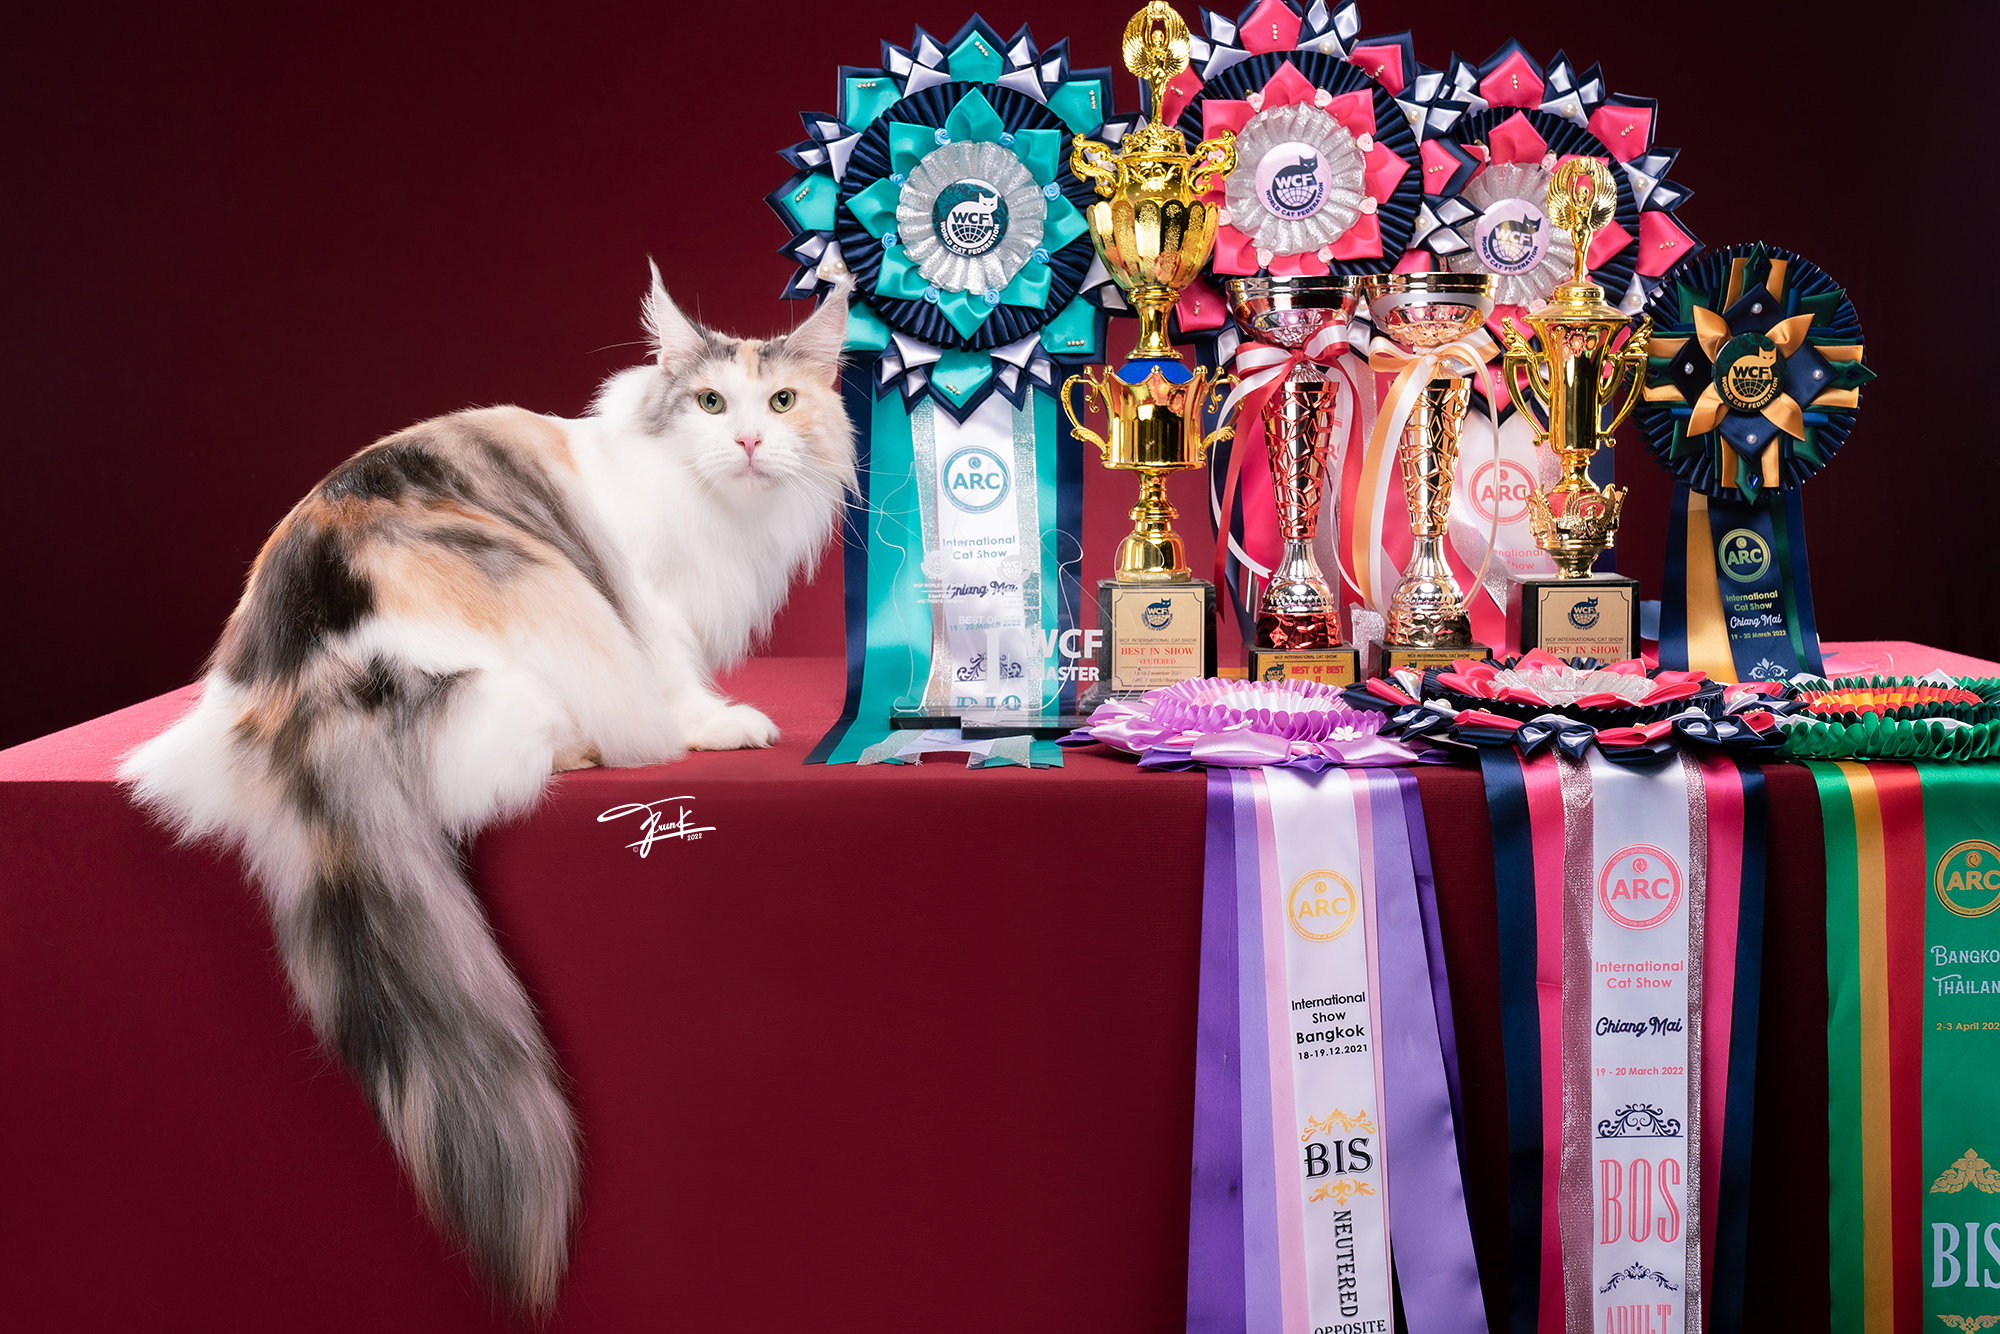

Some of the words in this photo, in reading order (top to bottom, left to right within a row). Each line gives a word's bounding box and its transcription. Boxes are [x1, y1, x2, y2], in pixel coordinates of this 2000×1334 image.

[1274, 173, 1312, 190] WCF
[1266, 189, 1280, 211] WORLD
[1298, 182, 1324, 216] FEDERATION
[952, 212, 989, 224] WCF
[940, 222, 952, 246] WORLD
[952, 244, 966, 254] CAT
[968, 224, 1000, 254] FEDERATION
[1495, 227, 1531, 244] WCF
[1482, 236, 1490, 259] WORLD
[1490, 260, 1503, 269] CAT
[1504, 246, 1538, 271] FEDERATION
[1733, 366, 1769, 378] WCF
[1722, 376, 1733, 400] WORLD
[1733, 399, 1746, 408] CAT
[1748, 377, 1778, 408] FEDERATION
[952, 472, 1000, 490] ARC
[1482, 485, 1526, 502] ARC
[942, 534, 1015, 547] International
[953, 550, 973, 560] Cat
[977, 550, 1007, 559] Show
[1728, 548, 1762, 565] ARC
[1726, 590, 1778, 602] International
[1750, 602, 1772, 610] Show
[1730, 616, 1760, 628] Chiang
[1760, 614, 1782, 626] Mai
[1024, 629, 1103, 658] WCF
[1547, 646, 1571, 654] BEST
[1576, 646, 1586, 654] IN
[1590, 646, 1620, 654] SHOW
[1291, 666, 1309, 674] BEST
[1313, 666, 1323, 674] OF
[1326, 666, 1344, 674] BEST
[1612, 878, 1670, 900] ARC
[1946, 870, 2000, 891] ARC
[1298, 897, 1347, 919] ARC
[1595, 960, 1684, 973] International
[1607, 978, 1631, 988] Cat
[1636, 977, 1672, 988] Show
[1292, 991, 1366, 1011] International
[1312, 1011, 1346, 1024] Show
[1296, 1025, 1365, 1045] Bangkok
[1596, 1017, 1647, 1037] Chiang
[1649, 1016, 1682, 1036] Mai
[1956, 1022, 1978, 1031] April
[1982, 1022, 2000, 1030] 202
[1298, 1044, 1368, 1060] 18-19.12.2021
[1596, 1068, 1606, 1076] 19
[1616, 1068, 1626, 1076] 20
[1629, 1067, 1658, 1075] March
[1662, 1066, 1684, 1075] 2022
[1304, 1137, 1373, 1180] BIS
[1600, 1158, 1680, 1244] BOS
[1333, 1210, 1359, 1318] NEUTERED
[1931, 1222, 2000, 1289] BIS
[1314, 1320, 1386, 1334] OPPOSITE
[1605, 1304, 1672, 1334] ADULT
